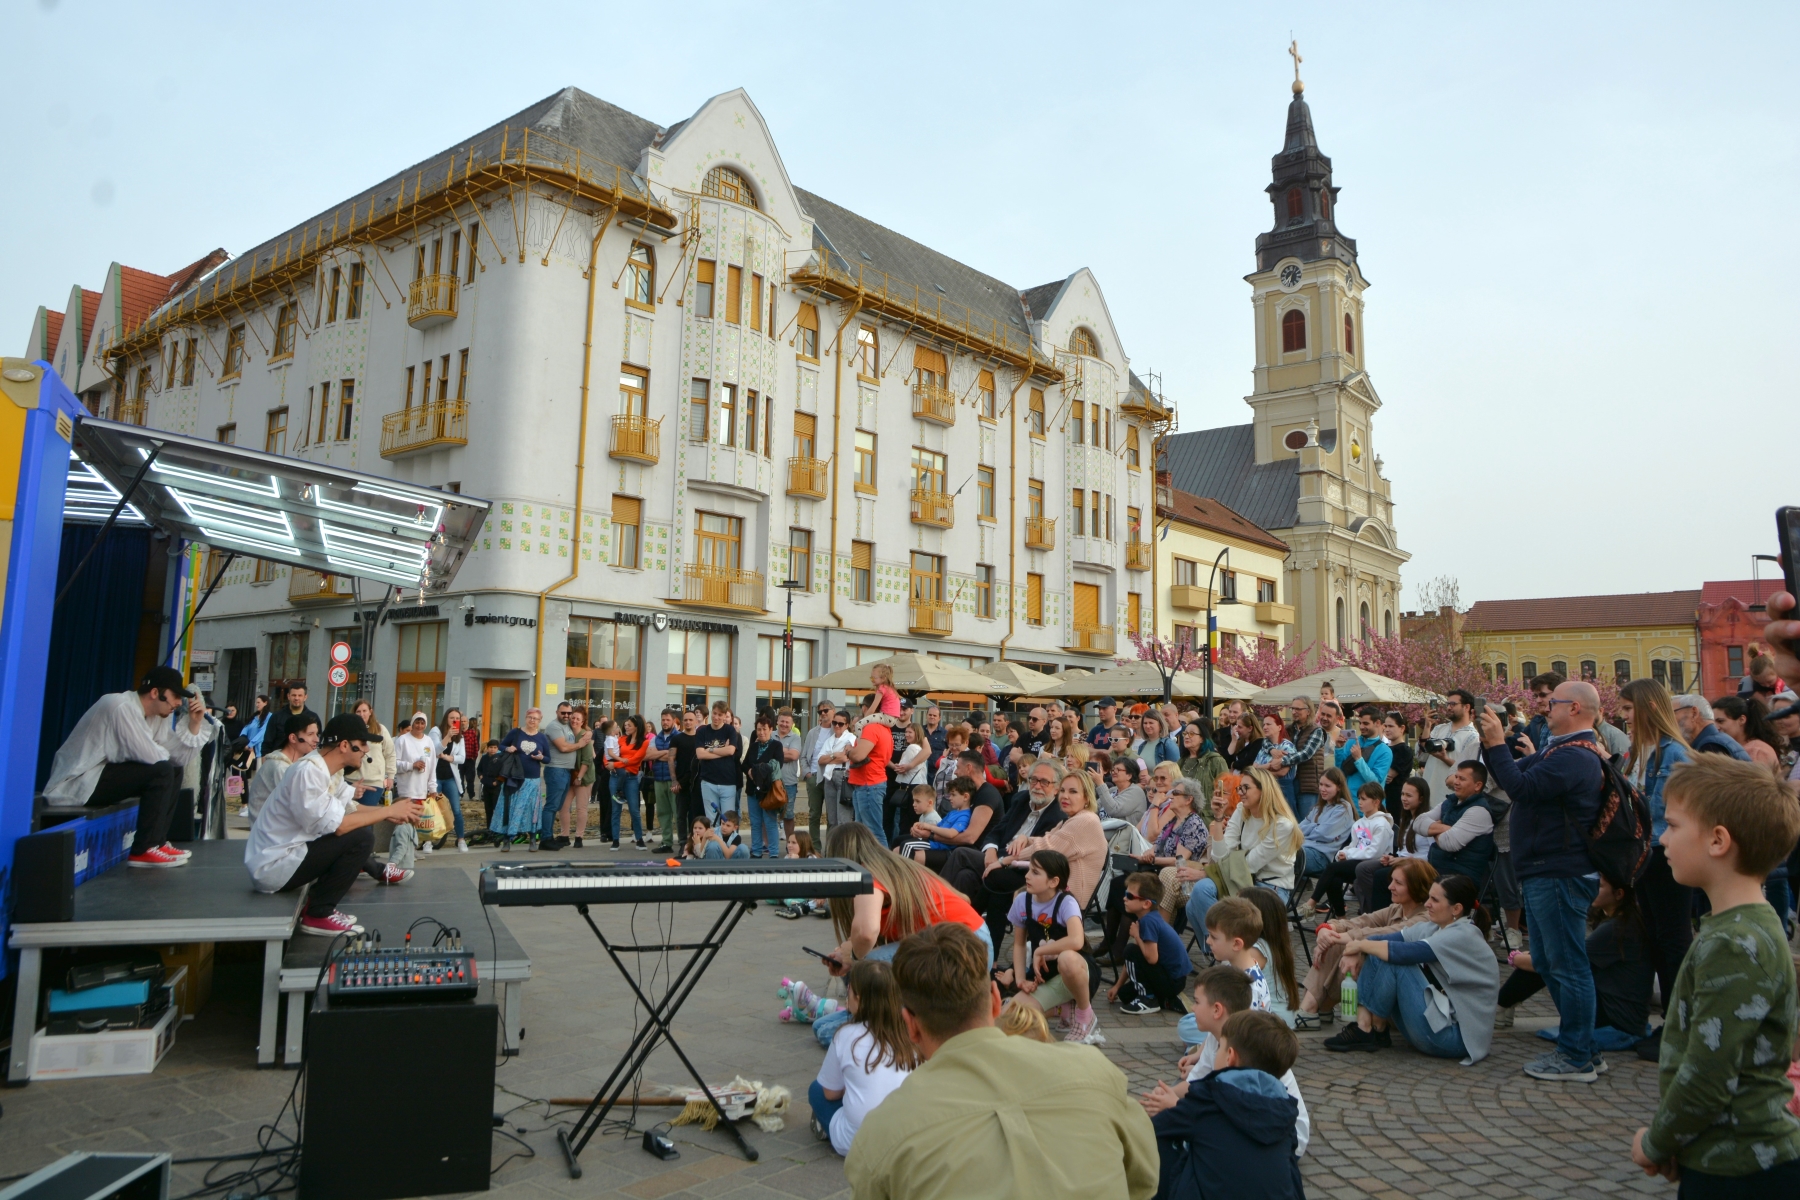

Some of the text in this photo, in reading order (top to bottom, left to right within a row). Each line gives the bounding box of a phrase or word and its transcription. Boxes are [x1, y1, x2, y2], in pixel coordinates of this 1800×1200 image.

[475, 613, 536, 628] sapientgroup
[615, 612, 651, 626] BANCA
[669, 618, 739, 634] TRANSILVANIA
